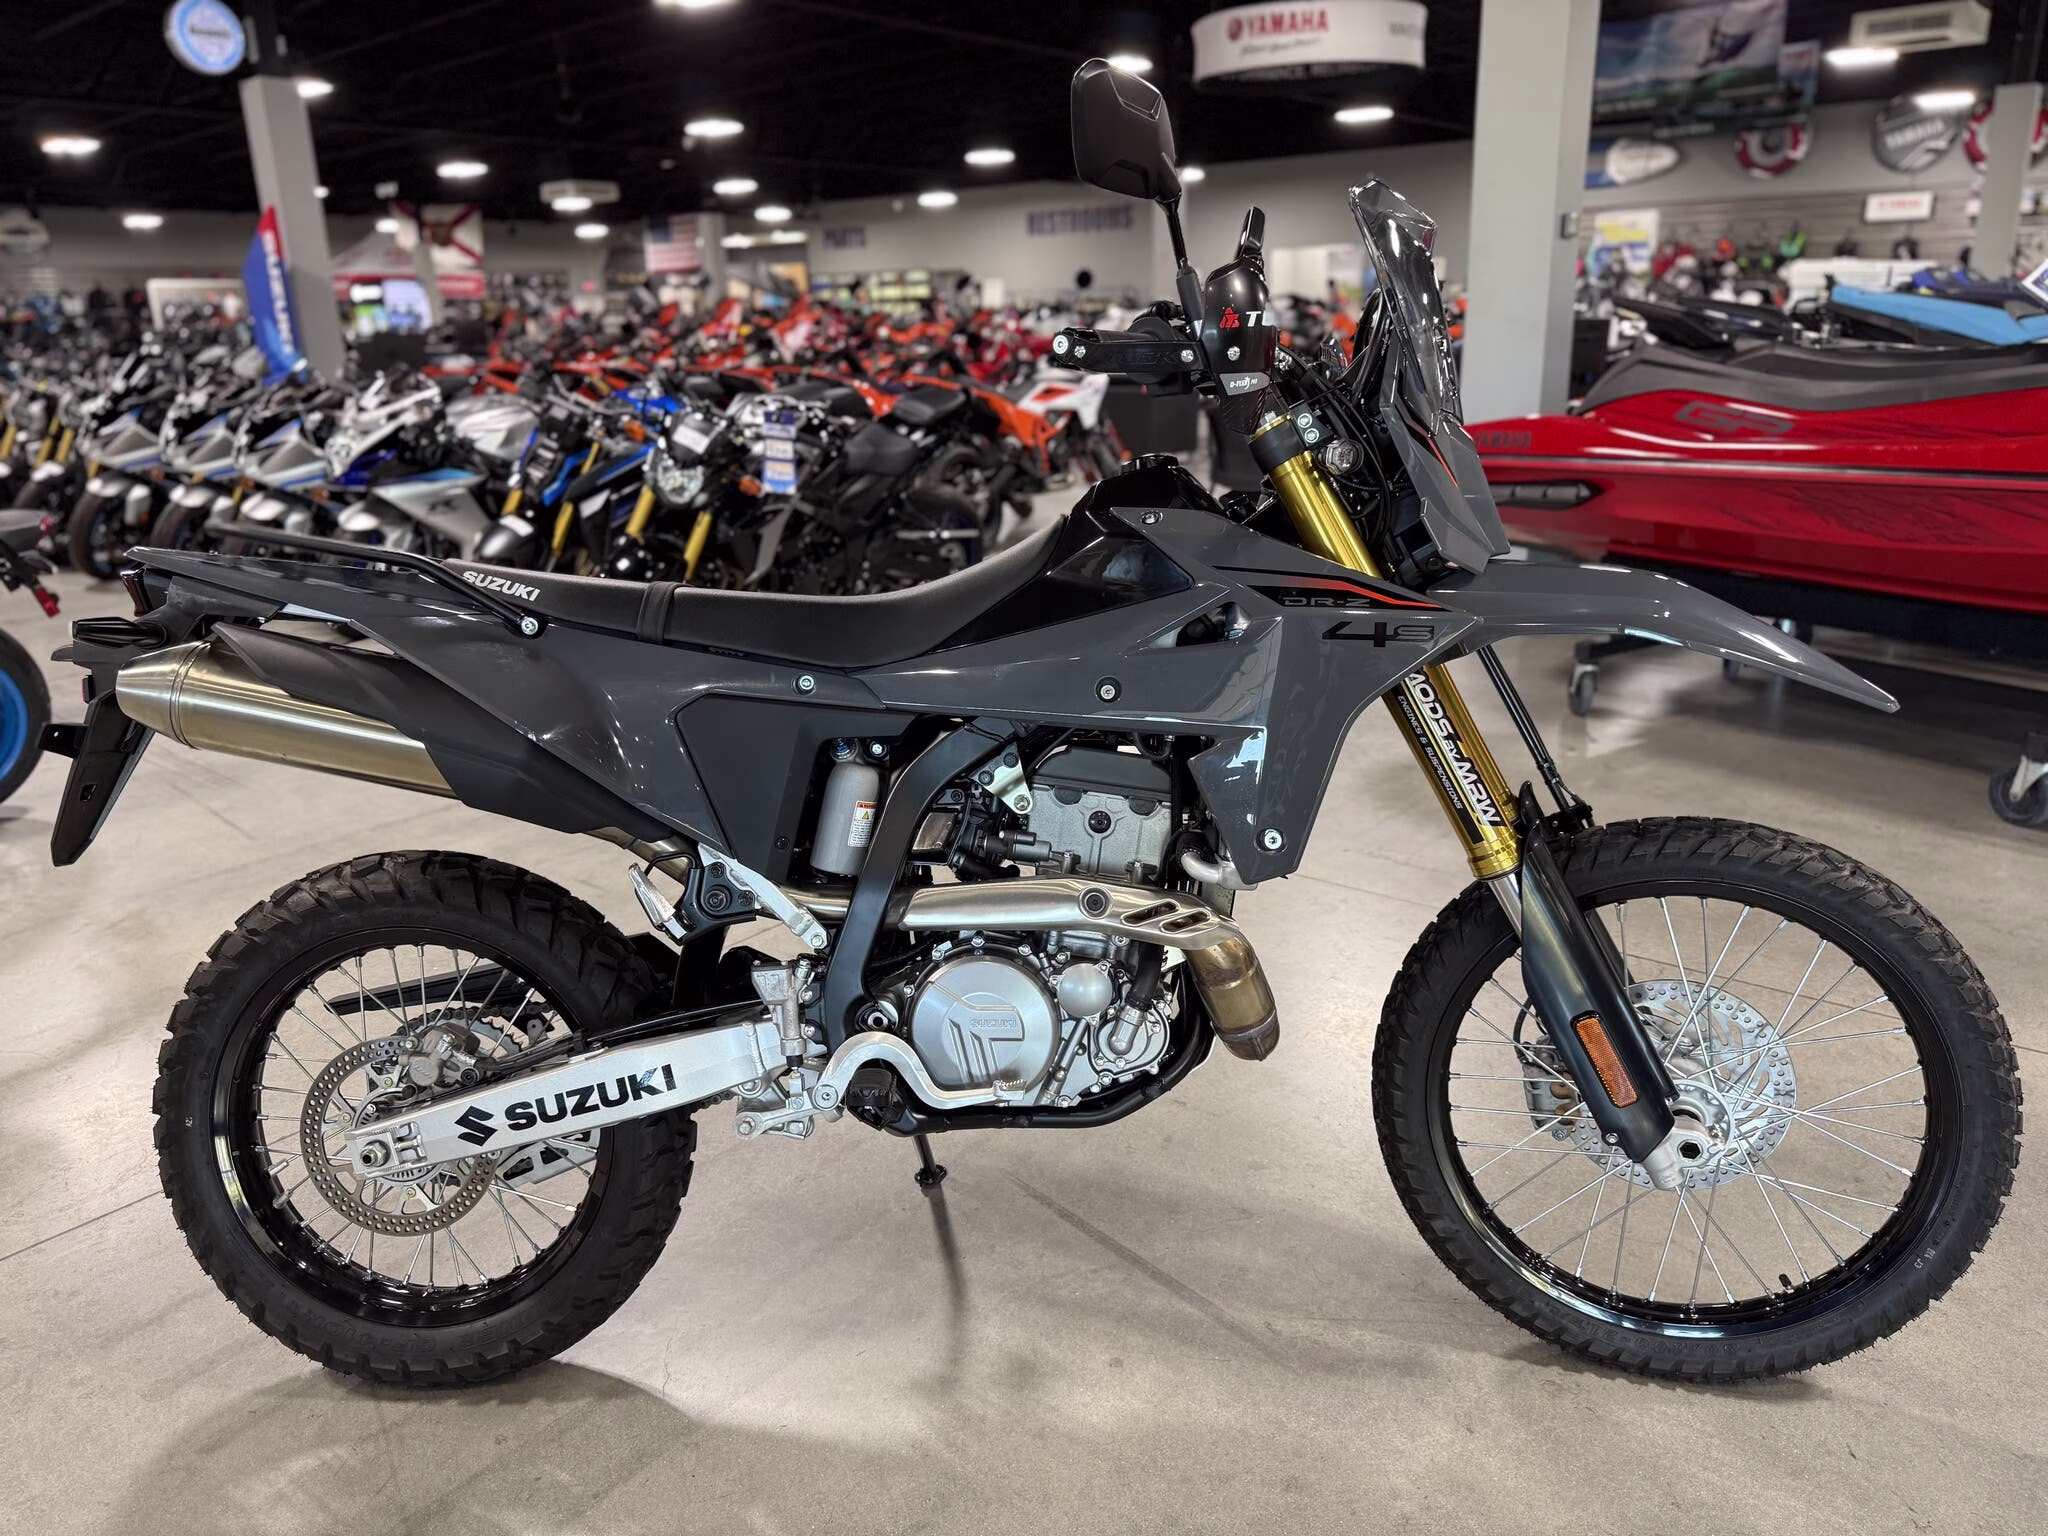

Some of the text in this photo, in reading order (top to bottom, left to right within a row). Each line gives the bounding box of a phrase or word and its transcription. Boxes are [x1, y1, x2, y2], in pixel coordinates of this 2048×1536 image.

[1248, 10, 1329, 36] YAMAHA
[463, 570, 541, 602] SUZUKI
[1284, 596, 1371, 608] DR-Z
[1398, 695, 1424, 735] ENGINES
[1425, 746, 1464, 810] SUSPENSIONS
[970, 1018, 1017, 1028] SUZUKI
[504, 1063, 678, 1131] SUZUKI
